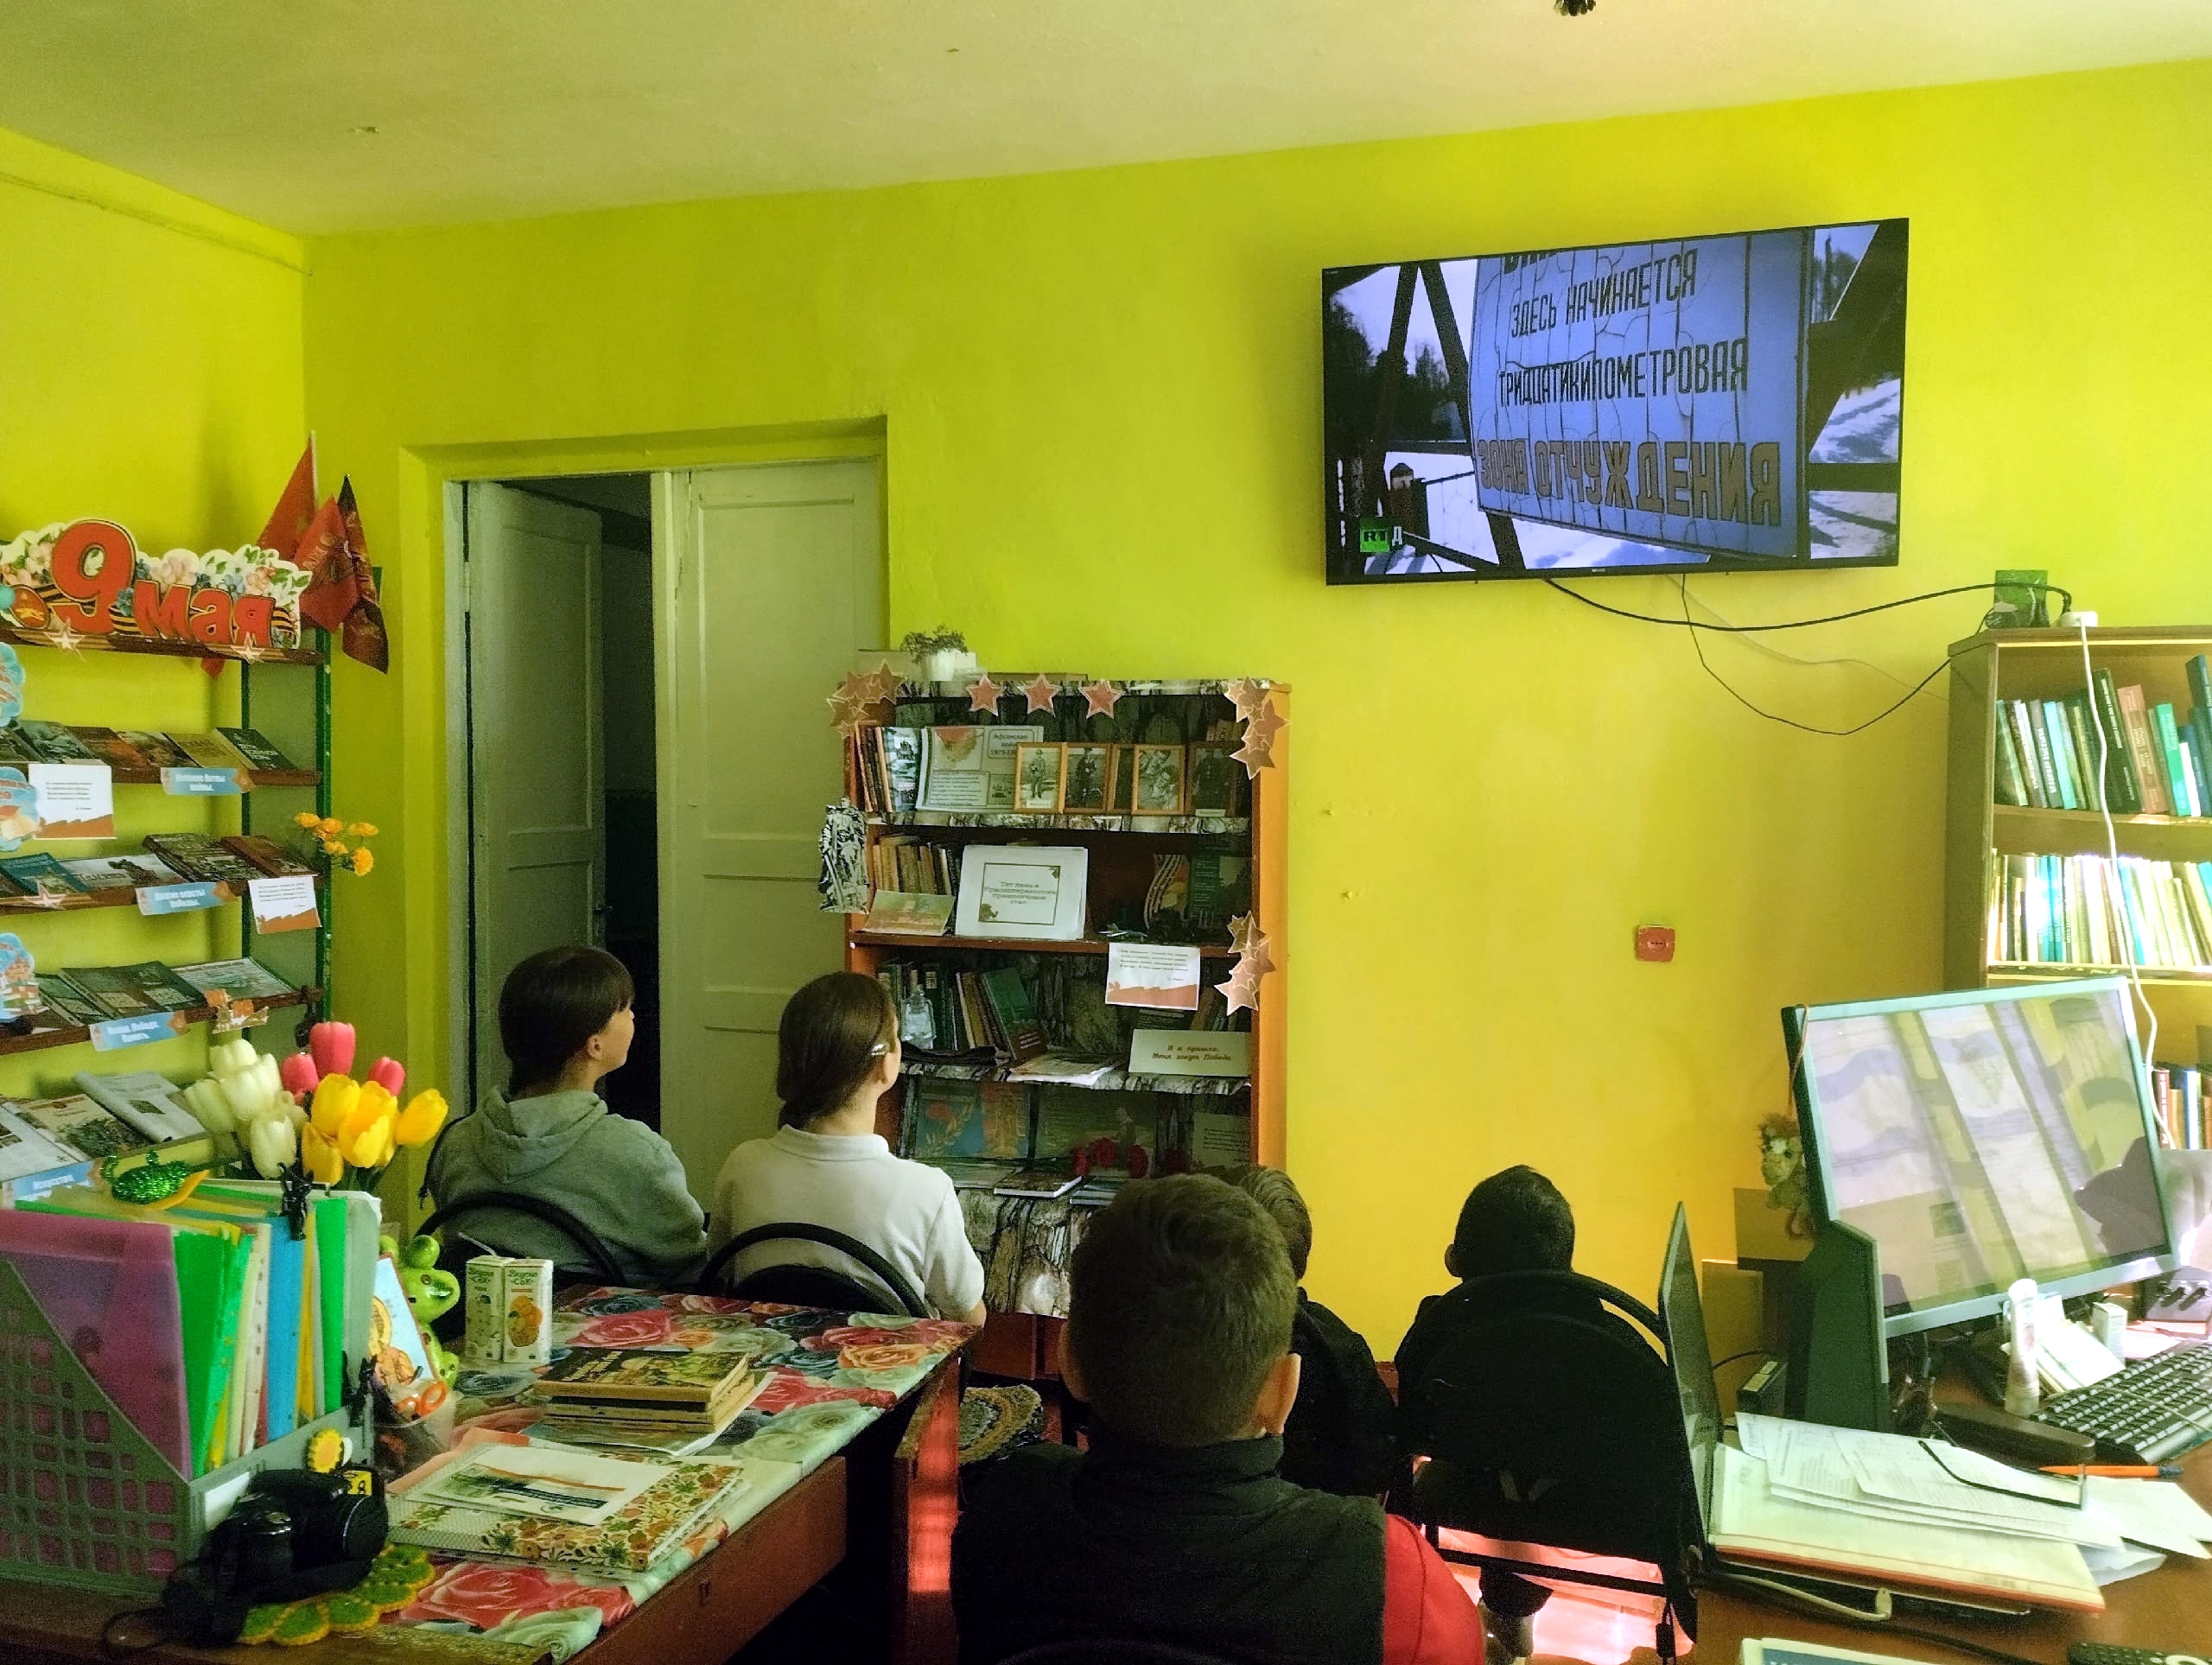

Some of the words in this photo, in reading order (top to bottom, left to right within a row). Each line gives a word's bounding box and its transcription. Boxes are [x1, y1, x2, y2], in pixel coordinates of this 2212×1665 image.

[1511, 292, 1557, 338] ЗДЕСЬ
[1566, 248, 1698, 325] НАЧИНАЕТСЯ
[1499, 337, 1748, 407] ТРИДЦАТИКИЛОМЕТРОВАЯ
[1477, 438, 1530, 495] ЗОНА
[1535, 439, 1782, 527] ОТЧУЖДЕНИЯ
[52, 519, 137, 634] 9
